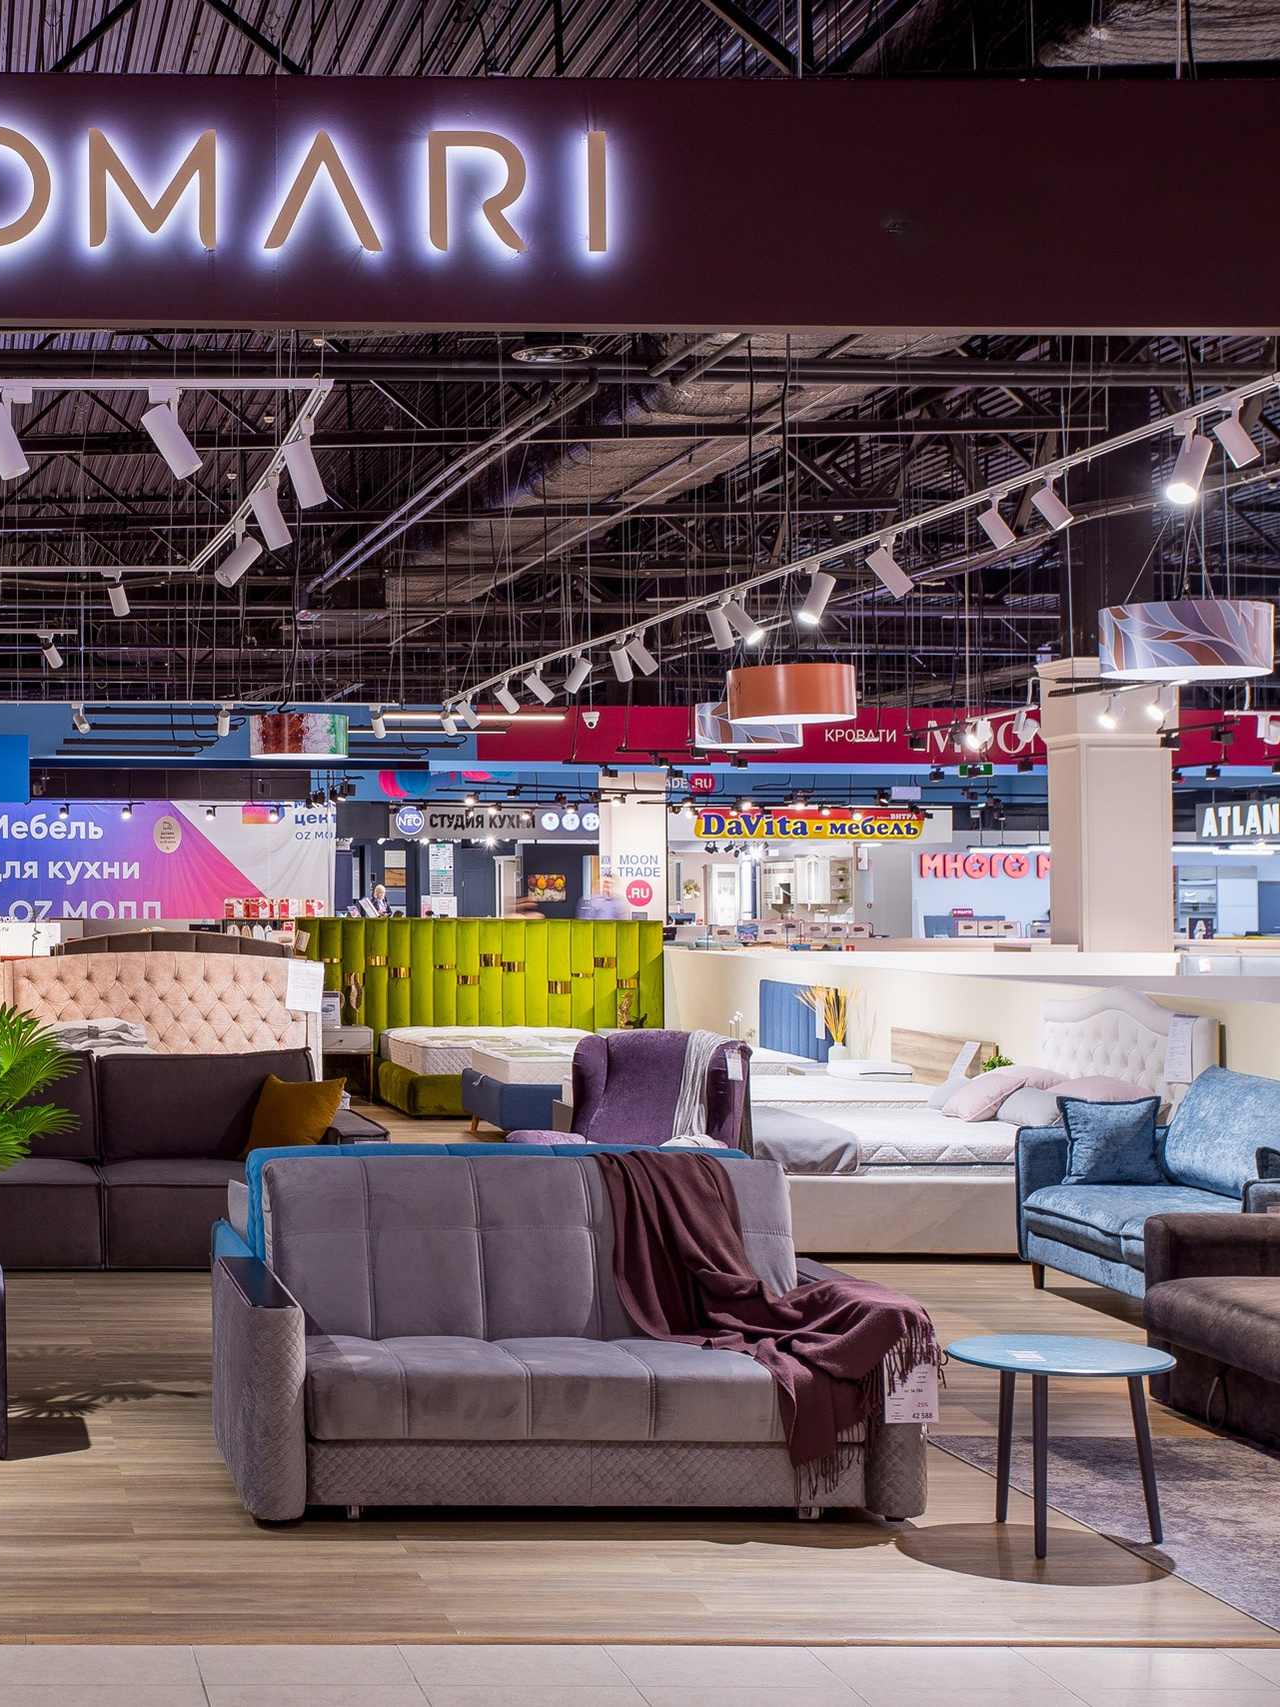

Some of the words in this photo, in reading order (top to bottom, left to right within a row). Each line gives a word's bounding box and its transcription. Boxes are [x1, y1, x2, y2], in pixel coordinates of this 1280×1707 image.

[825, 729, 897, 742] КРОВАТИ
[926, 720, 1038, 754] MOO
[666, 778, 688, 788] ADE
[692, 778, 712, 788] .RU
[429, 813, 484, 831] СТУДИЯ
[489, 814, 535, 829] КУХНИ
[701, 813, 808, 836] DaVita
[829, 816, 919, 836] мебель
[295, 831, 311, 840] OZ
[314, 831, 336, 840] МО
[619, 855, 658, 865] MOON
[919, 852, 1030, 880] МНОГО
[48, 861, 140, 885] кухни
[617, 867, 661, 877] TRADE
[628, 888, 650, 898] .RU
[8, 900, 53, 923] OZ
